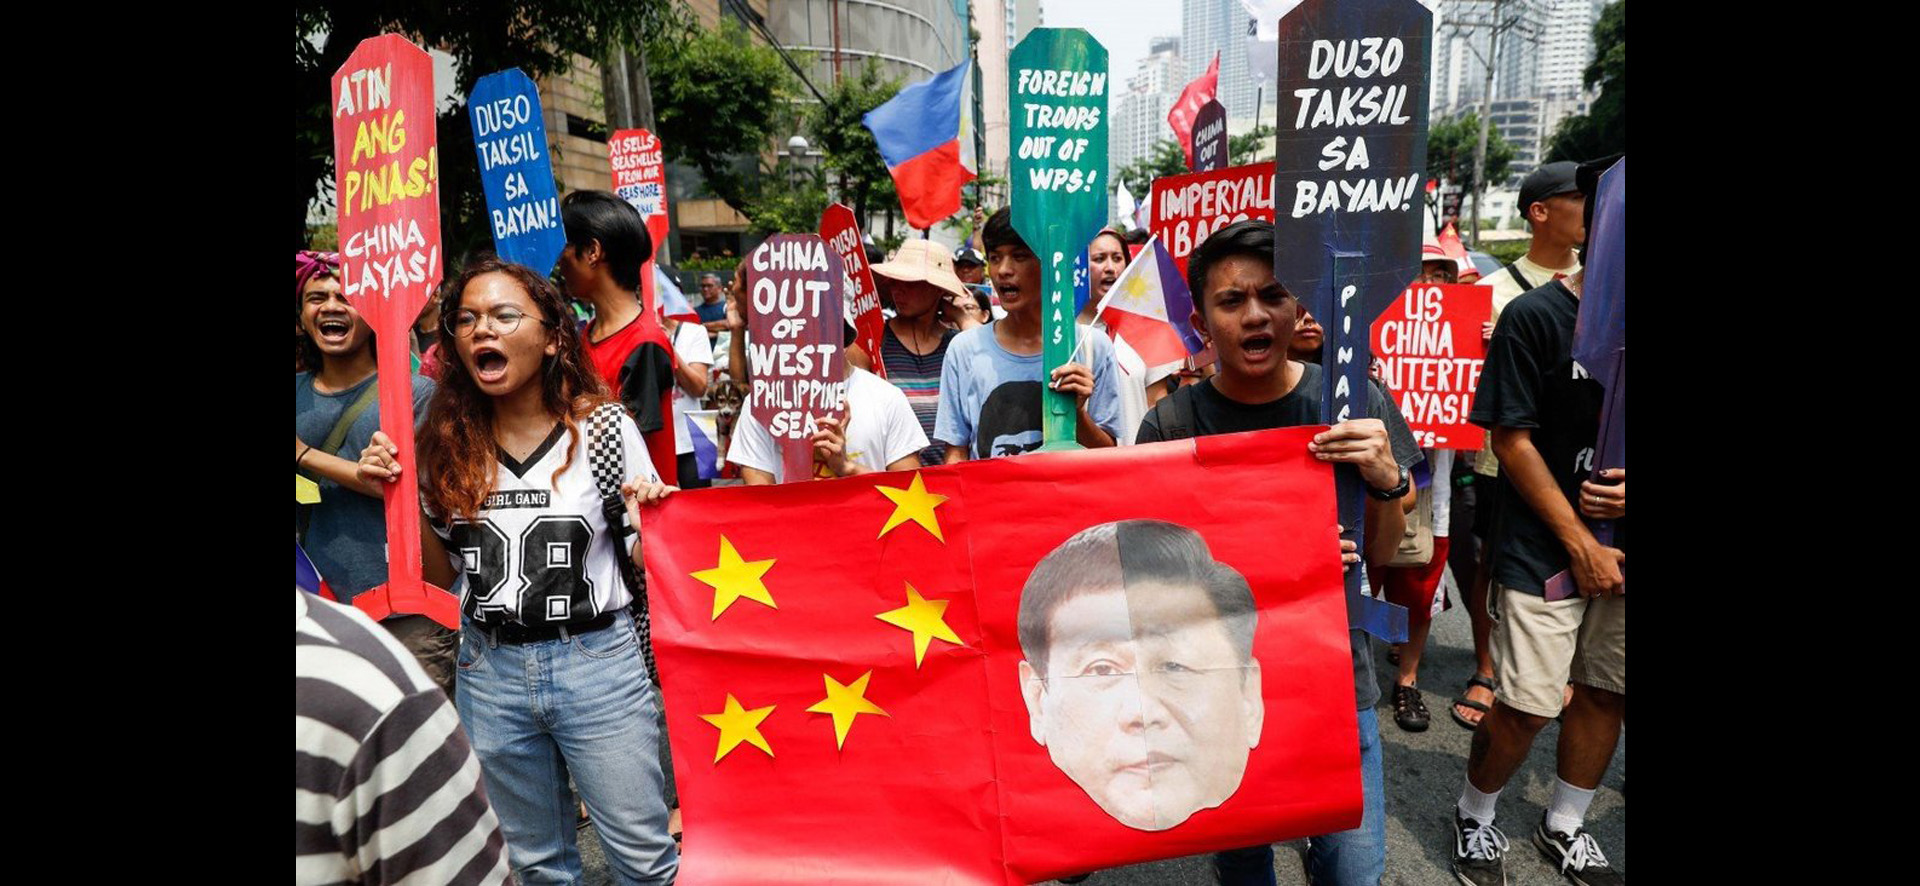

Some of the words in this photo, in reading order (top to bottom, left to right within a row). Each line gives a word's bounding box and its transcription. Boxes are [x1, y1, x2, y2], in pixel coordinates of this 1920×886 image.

[1308, 37, 1404, 79] DU30
[336, 63, 392, 118] ATIN
[1018, 69, 1106, 97] FOREIGN
[475, 94, 530, 137] DU30
[1024, 103, 1100, 131] TROOPS
[1294, 84, 1411, 130] TAKSIL
[351, 109, 406, 165] ANG
[608, 139, 621, 156] XI
[622, 135, 656, 153] SELLS
[1018, 136, 1055, 160] OUT
[1058, 140, 1089, 162] OF
[1195, 117, 1224, 147] CHINA
[478, 131, 540, 171] TAKSIL
[1200, 142, 1219, 161] OUT
[1318, 135, 1369, 171] SA
[345, 146, 438, 216] PINAS!
[505, 173, 528, 201] SA
[1029, 170, 1097, 193] WPS!
[1292, 172, 1419, 218] BAYAN!
[493, 197, 557, 239] BAYAN!
[345, 218, 425, 258] CHINA
[752, 240, 829, 272] CHINA
[343, 245, 437, 299] LAYAS!
[752, 277, 831, 318] OUT
[1051, 251, 1063, 345] PINAS
[1404, 286, 1443, 322] US
[771, 318, 807, 339] OF
[1380, 321, 1454, 357] CHINA
[750, 343, 837, 377] WEST
[753, 379, 845, 411] PHILIPPINE
[1400, 391, 1469, 425] AYAS!
[769, 411, 832, 439] SEA
[484, 493, 512, 506] GIRL
[515, 492, 547, 505] GANG
[447, 515, 600, 627] 28
